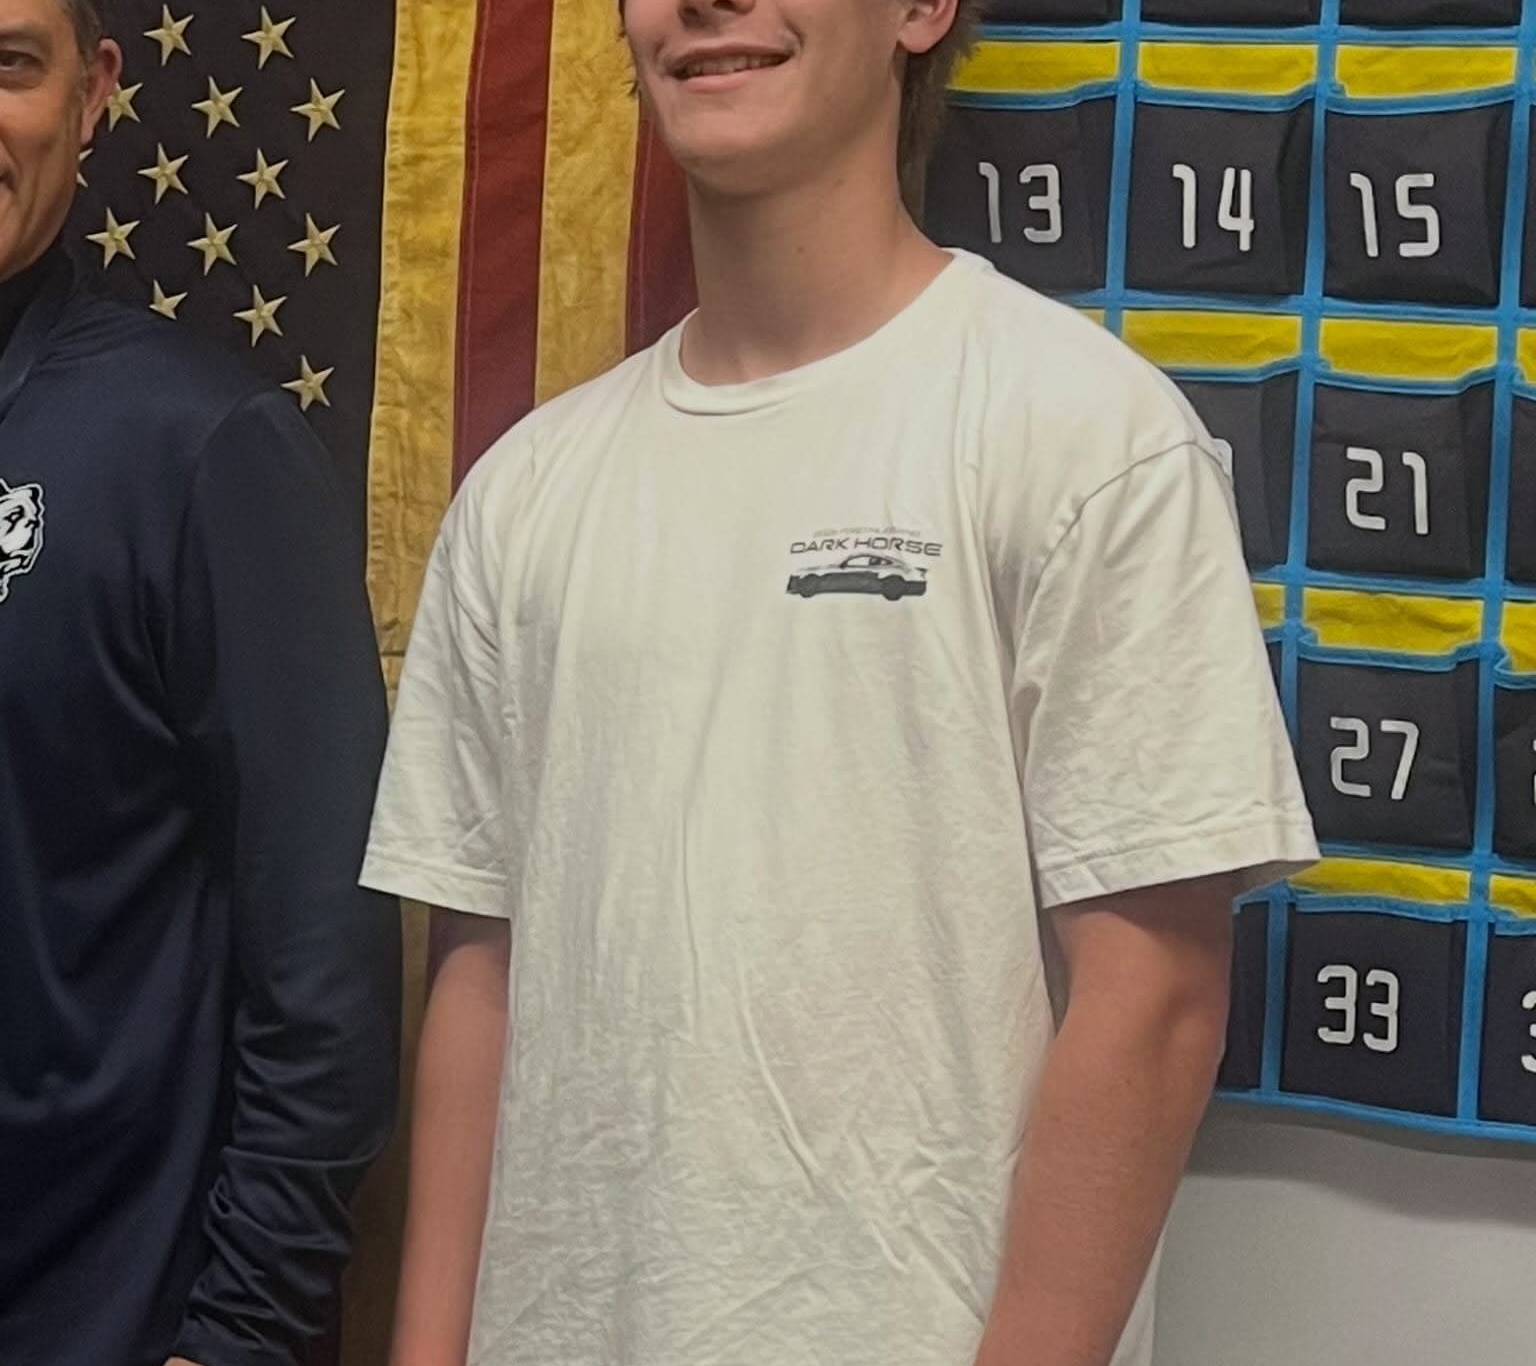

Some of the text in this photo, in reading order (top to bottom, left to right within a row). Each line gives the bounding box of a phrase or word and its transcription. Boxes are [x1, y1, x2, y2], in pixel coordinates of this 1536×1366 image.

[980, 163, 1439, 257] 13 14 15
[1346, 447, 1428, 534] 21
[790, 537, 944, 557] DARK HORSE
[1331, 717, 1418, 799] 27
[1318, 966, 1398, 1051] 33
